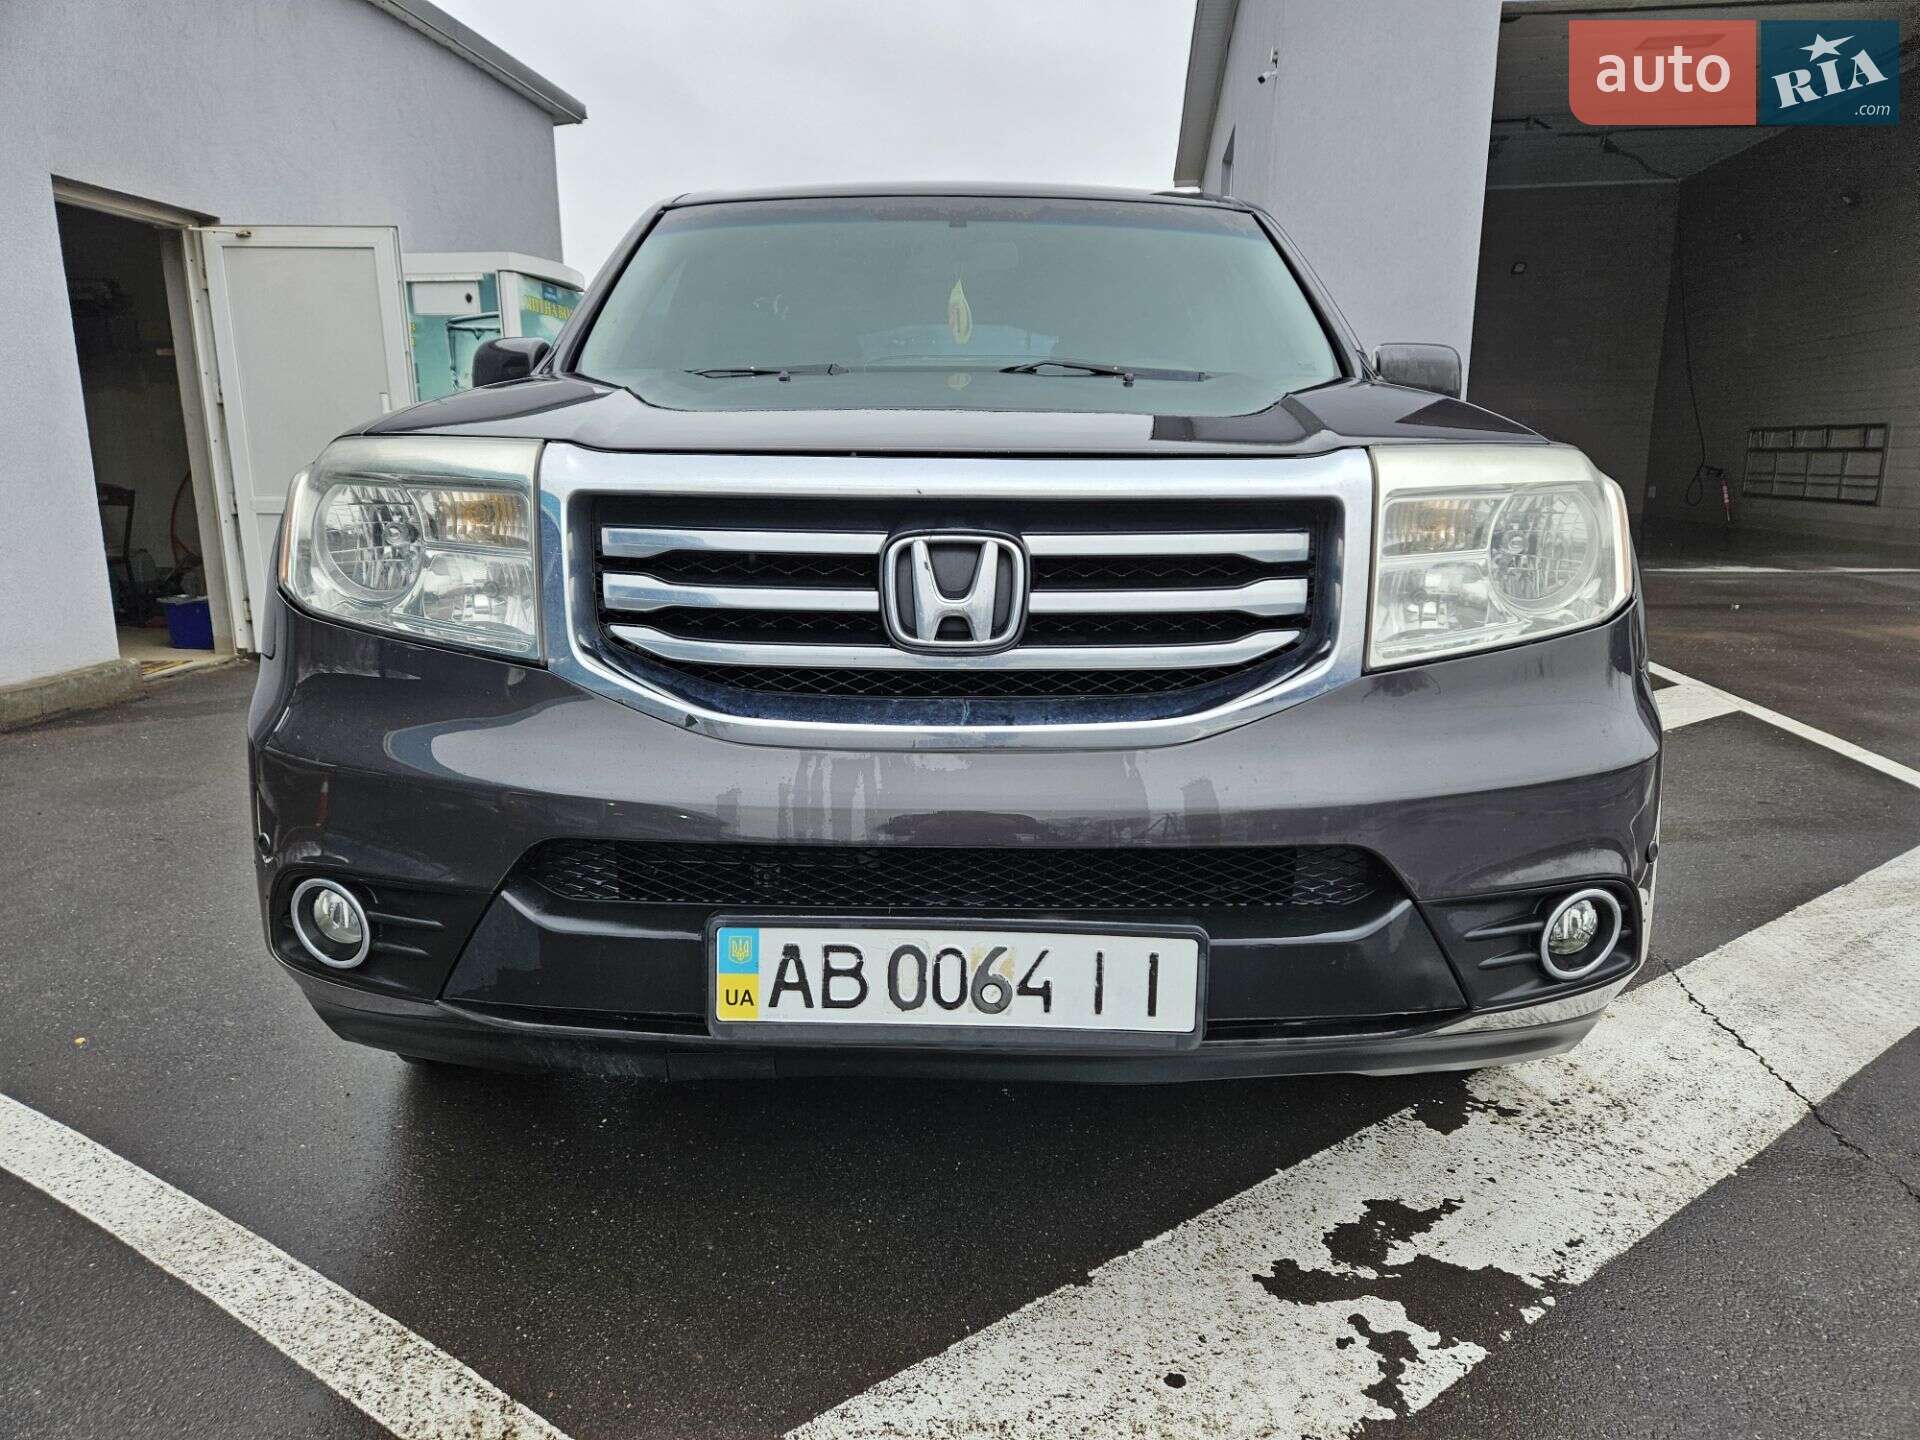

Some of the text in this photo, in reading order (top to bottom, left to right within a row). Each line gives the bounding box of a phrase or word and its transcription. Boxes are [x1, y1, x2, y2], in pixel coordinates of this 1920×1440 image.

[725, 989, 755, 1007] UA
[768, 943, 868, 1009] AB
[887, 944, 1054, 1014] 0064
